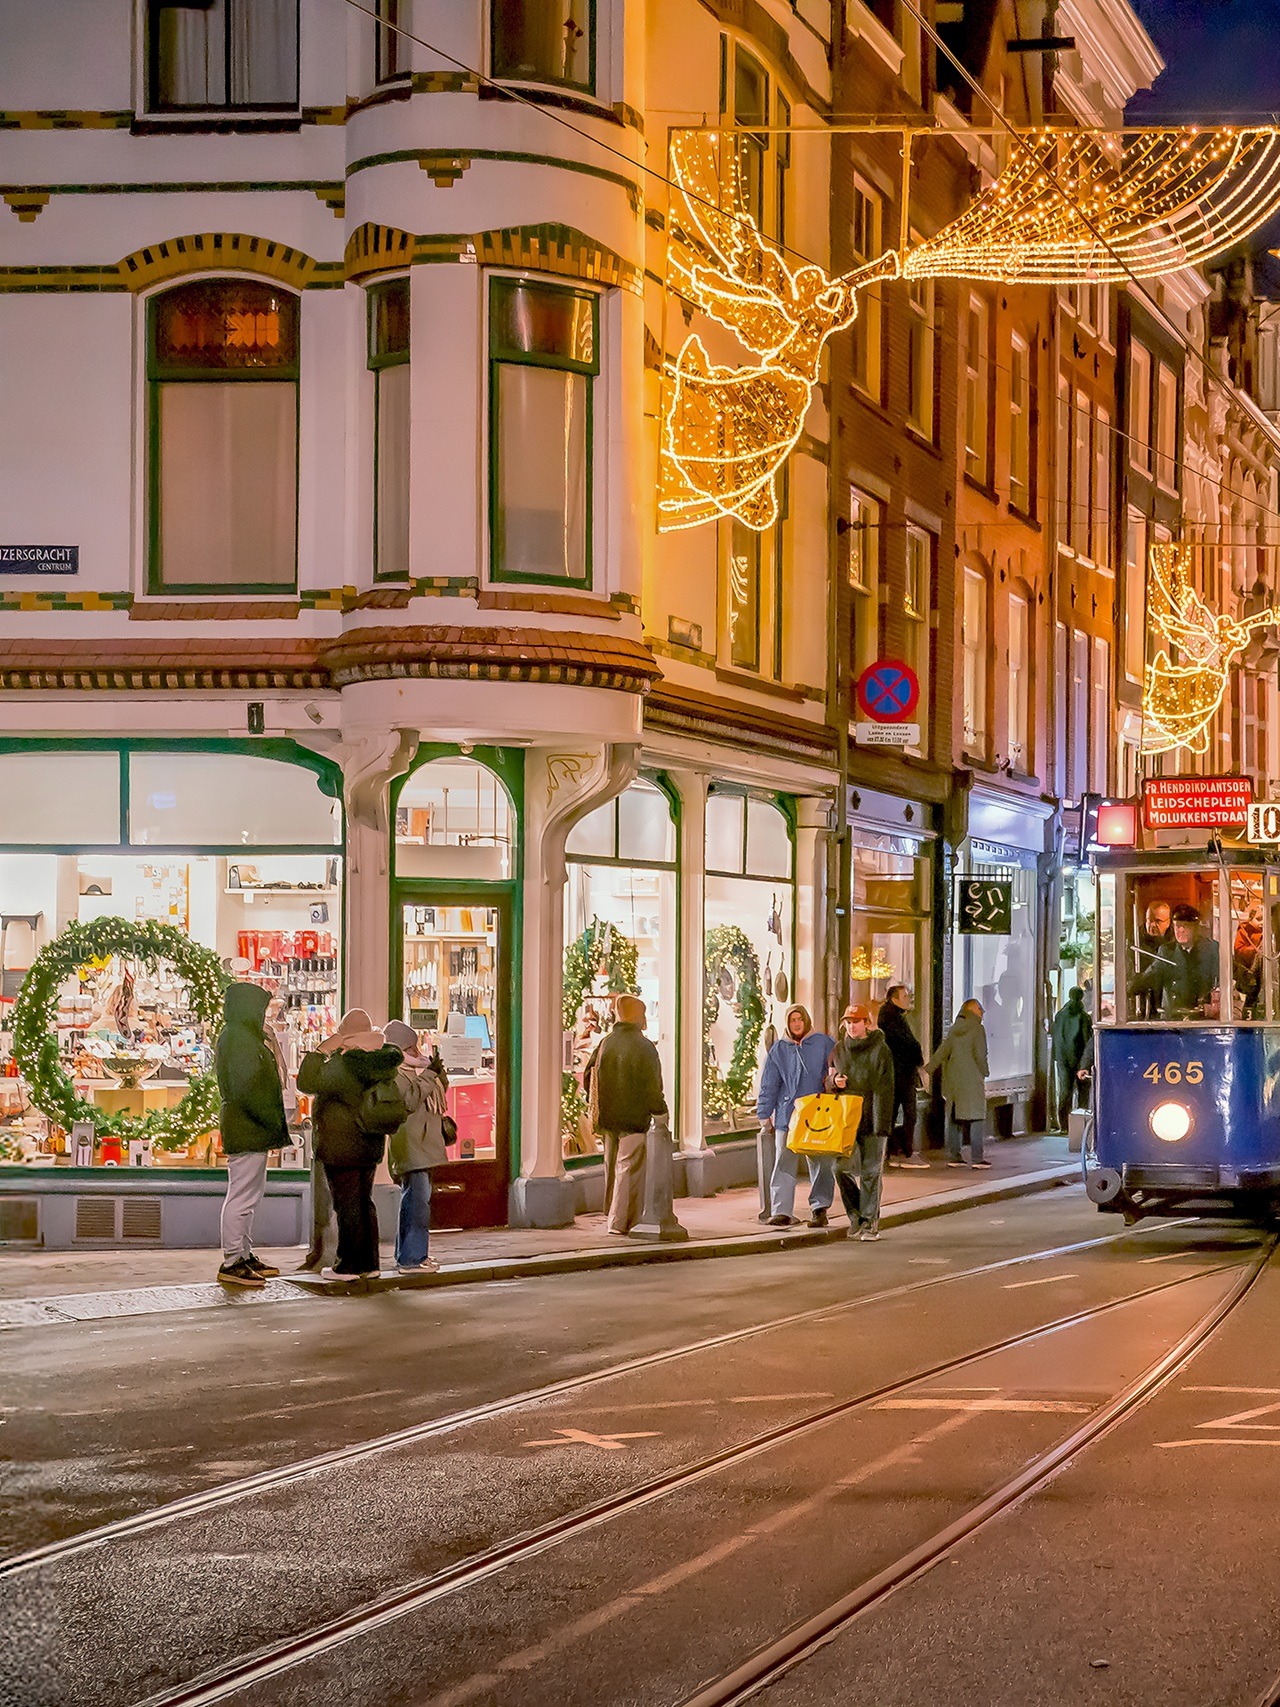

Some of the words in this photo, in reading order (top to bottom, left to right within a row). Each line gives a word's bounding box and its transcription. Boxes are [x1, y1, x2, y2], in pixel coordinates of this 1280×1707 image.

[37, 563, 72, 571] CENTRUM
[1151, 797, 1245, 809] LEIDSCHEPLEIN
[1150, 811, 1247, 823] MOLUKKENSTRAAT
[1251, 807, 1280, 840] 10
[1246, 1010, 1252, 1020] 3
[1143, 1061, 1204, 1084] 465
